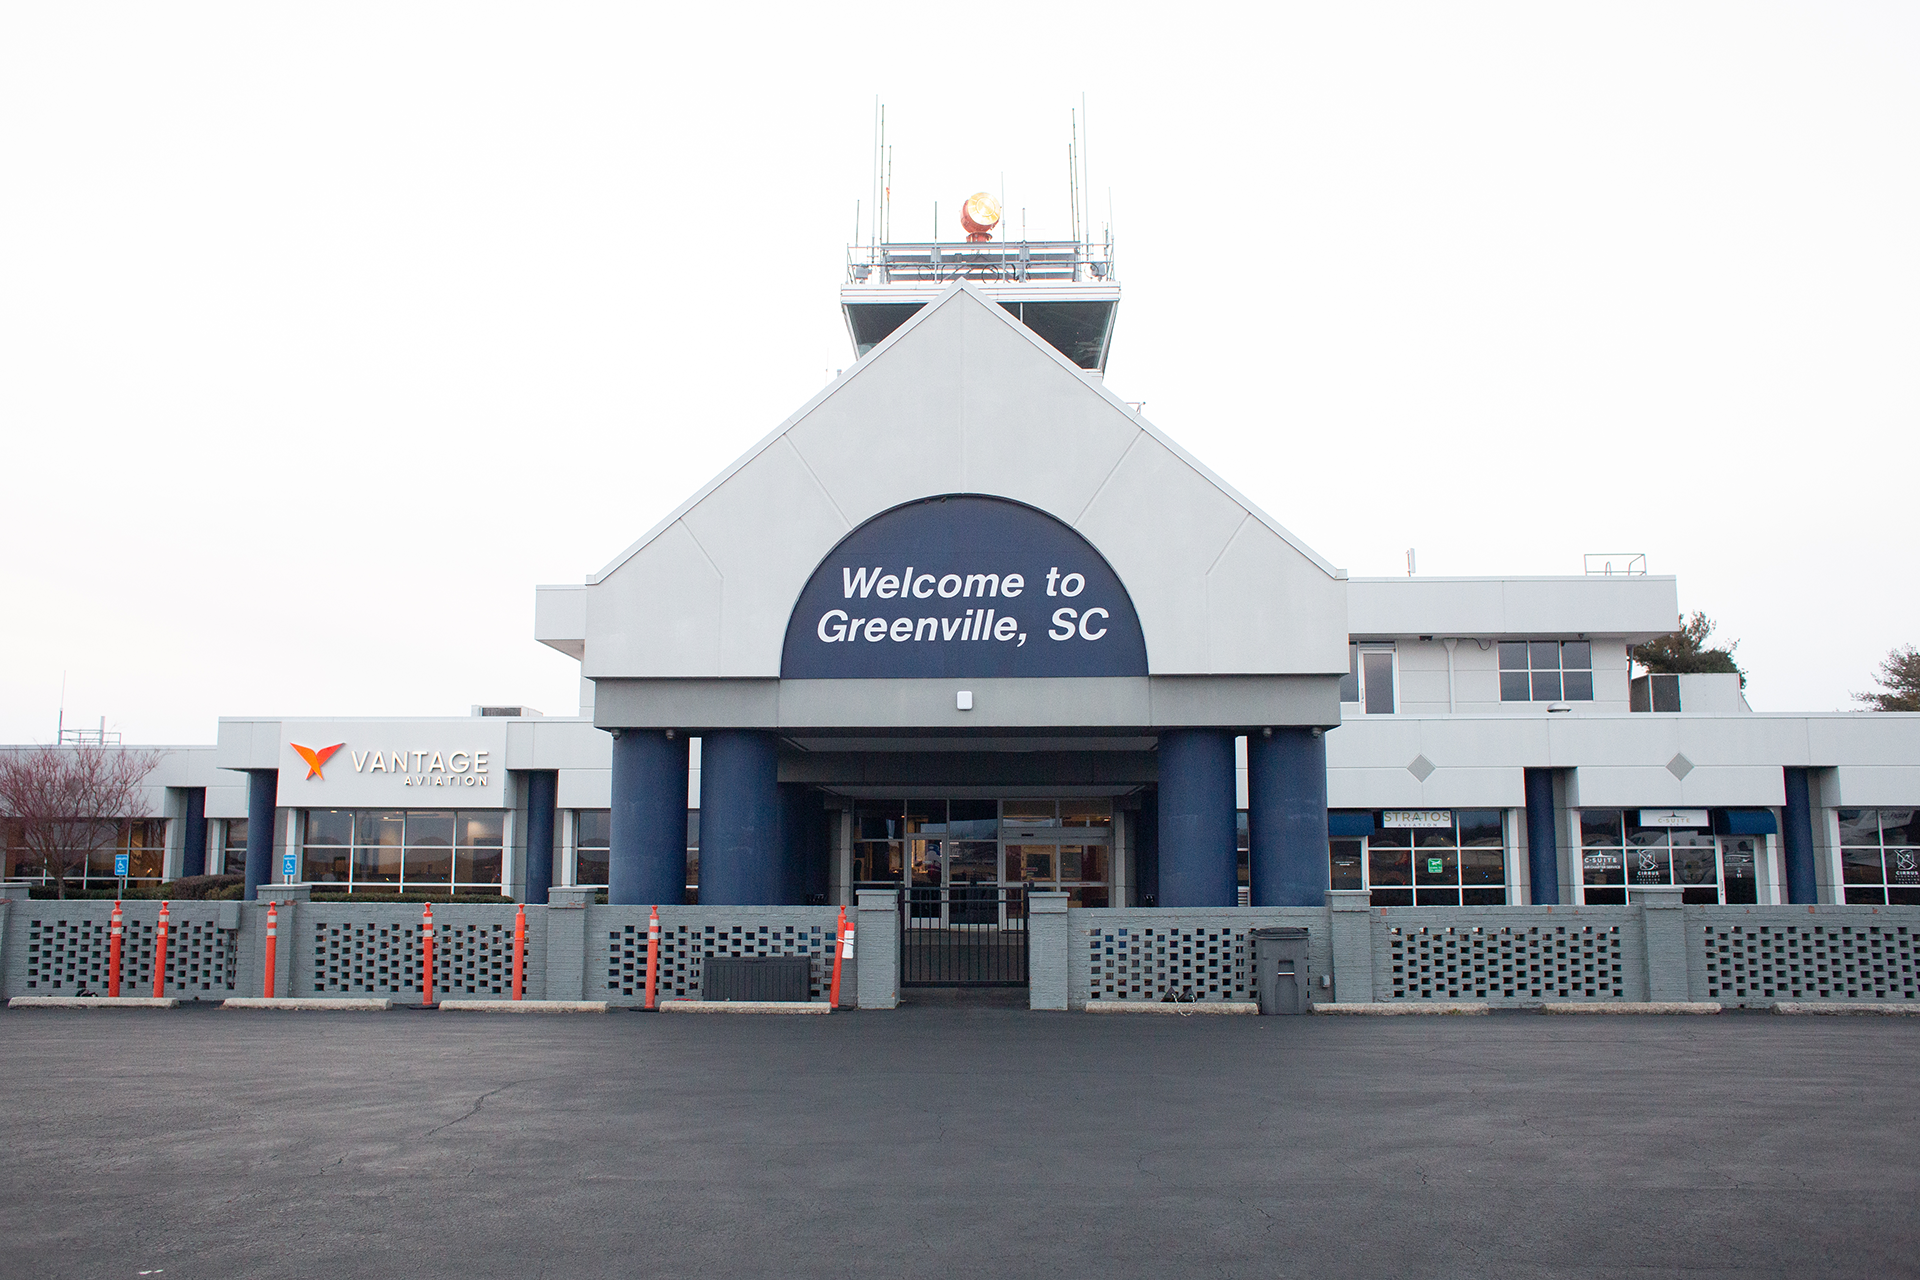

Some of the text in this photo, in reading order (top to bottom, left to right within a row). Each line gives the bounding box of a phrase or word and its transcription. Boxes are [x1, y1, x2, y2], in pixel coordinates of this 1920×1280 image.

[842, 567, 1086, 599] Welcome to
[817, 607, 1109, 648] Greenville, SC
[351, 750, 489, 773] VANTAGE
[403, 775, 489, 787] AVIATION
[1384, 811, 1450, 822] STRATOS
